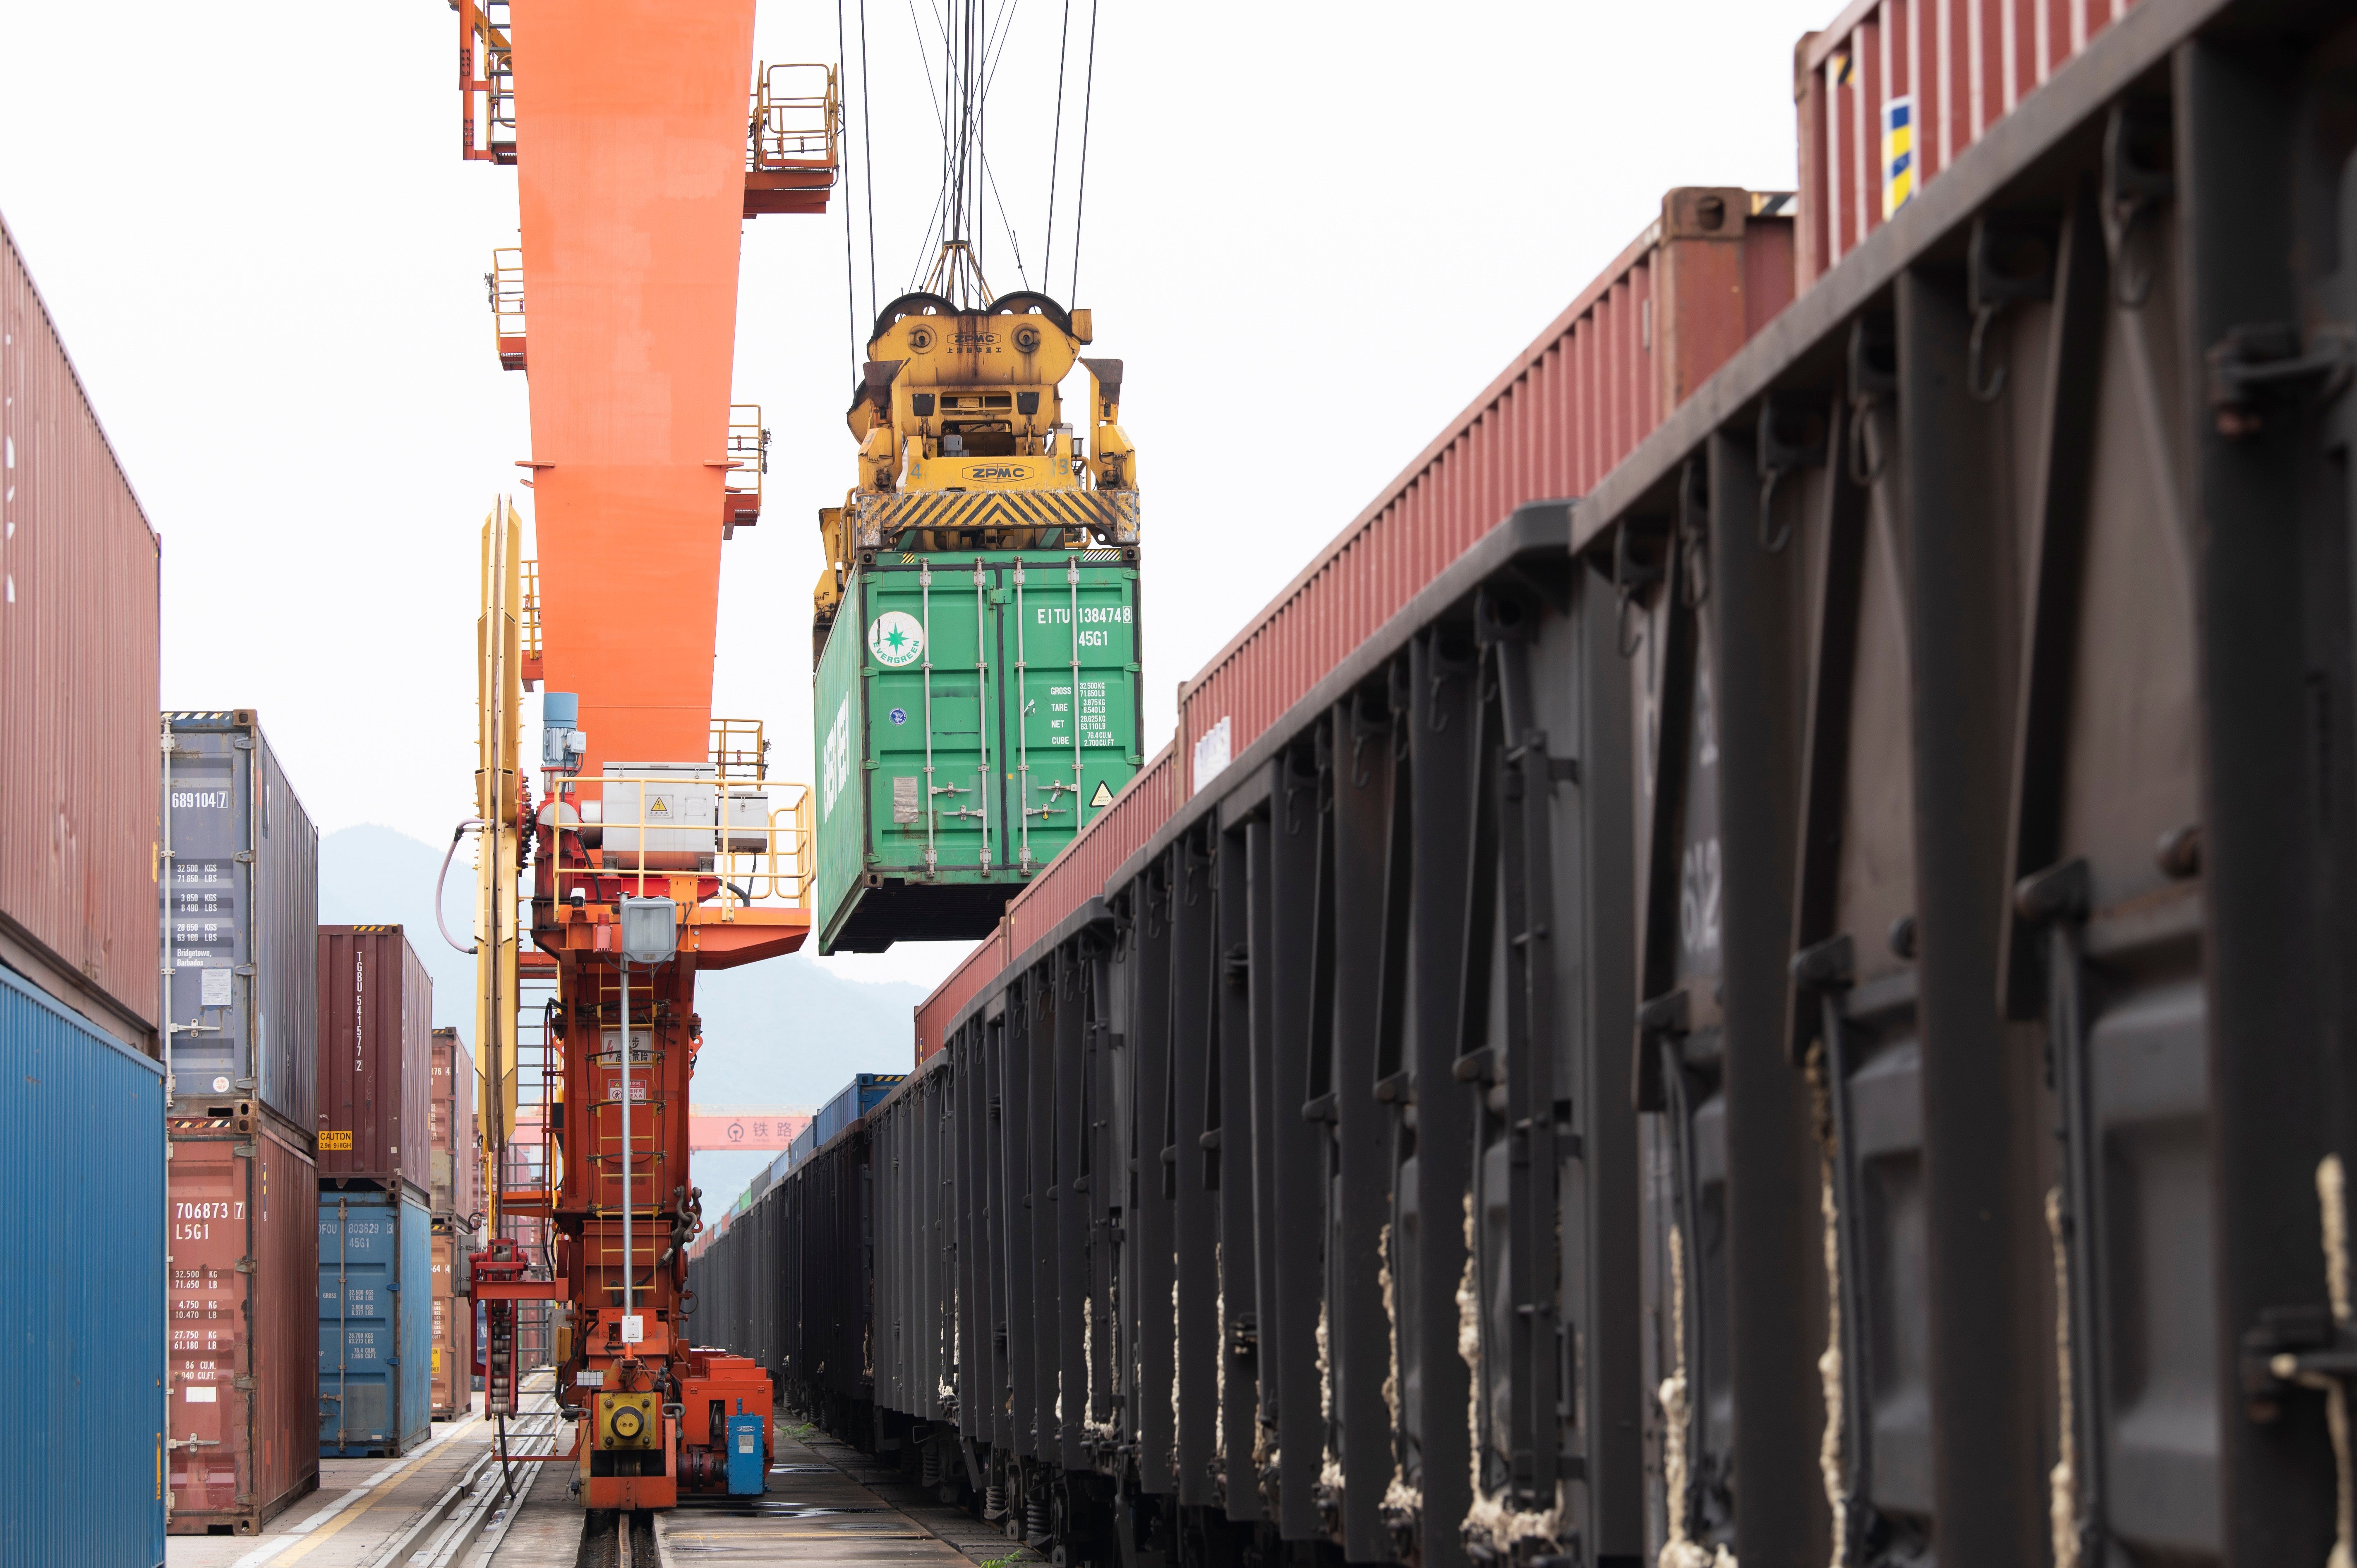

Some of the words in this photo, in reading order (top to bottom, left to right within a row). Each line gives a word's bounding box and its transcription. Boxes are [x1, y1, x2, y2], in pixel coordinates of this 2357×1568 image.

[1059, 458, 1068, 475] 3
[911, 464, 922, 480] 4
[973, 468, 1025, 478] ZPMC
[1038, 608, 1070, 624] EITU
[1079, 631, 1108, 646] 45G1
[873, 640, 919, 663] EVERGREEN
[177, 948, 212, 958] Bridgetown,
[629, 1036, 640, 1049] 步
[616, 1052, 648, 1062] 高危险
[356, 1060, 362, 1071] 2
[446, 1067, 451, 1075] 4
[753, 1122, 806, 1137] 铁路
[176, 1202, 228, 1219] 706873
[235, 1202, 245, 1219] 7
[176, 1224, 209, 1240] L5G1
[349, 1223, 379, 1234] 803629
[387, 1223, 393, 1234] 3
[349, 1238, 369, 1248] 45G1
[431, 1264, 440, 1273] 64
[445, 1264, 451, 1274] 4
[175, 1280, 199, 1289] 71,650
[209, 1280, 217, 1289] LB
[179, 1300, 199, 1309] 4,750
[209, 1300, 217, 1309] KG
[175, 1331, 199, 1339] 27,750
[208, 1331, 217, 1339] KG
[175, 1341, 199, 1350] 61,180
[208, 1341, 217, 1350] LB
[186, 1361, 194, 1369] 86
[200, 1361, 216, 1369] CU.M.
[198, 1372, 216, 1380] CU.FT.
